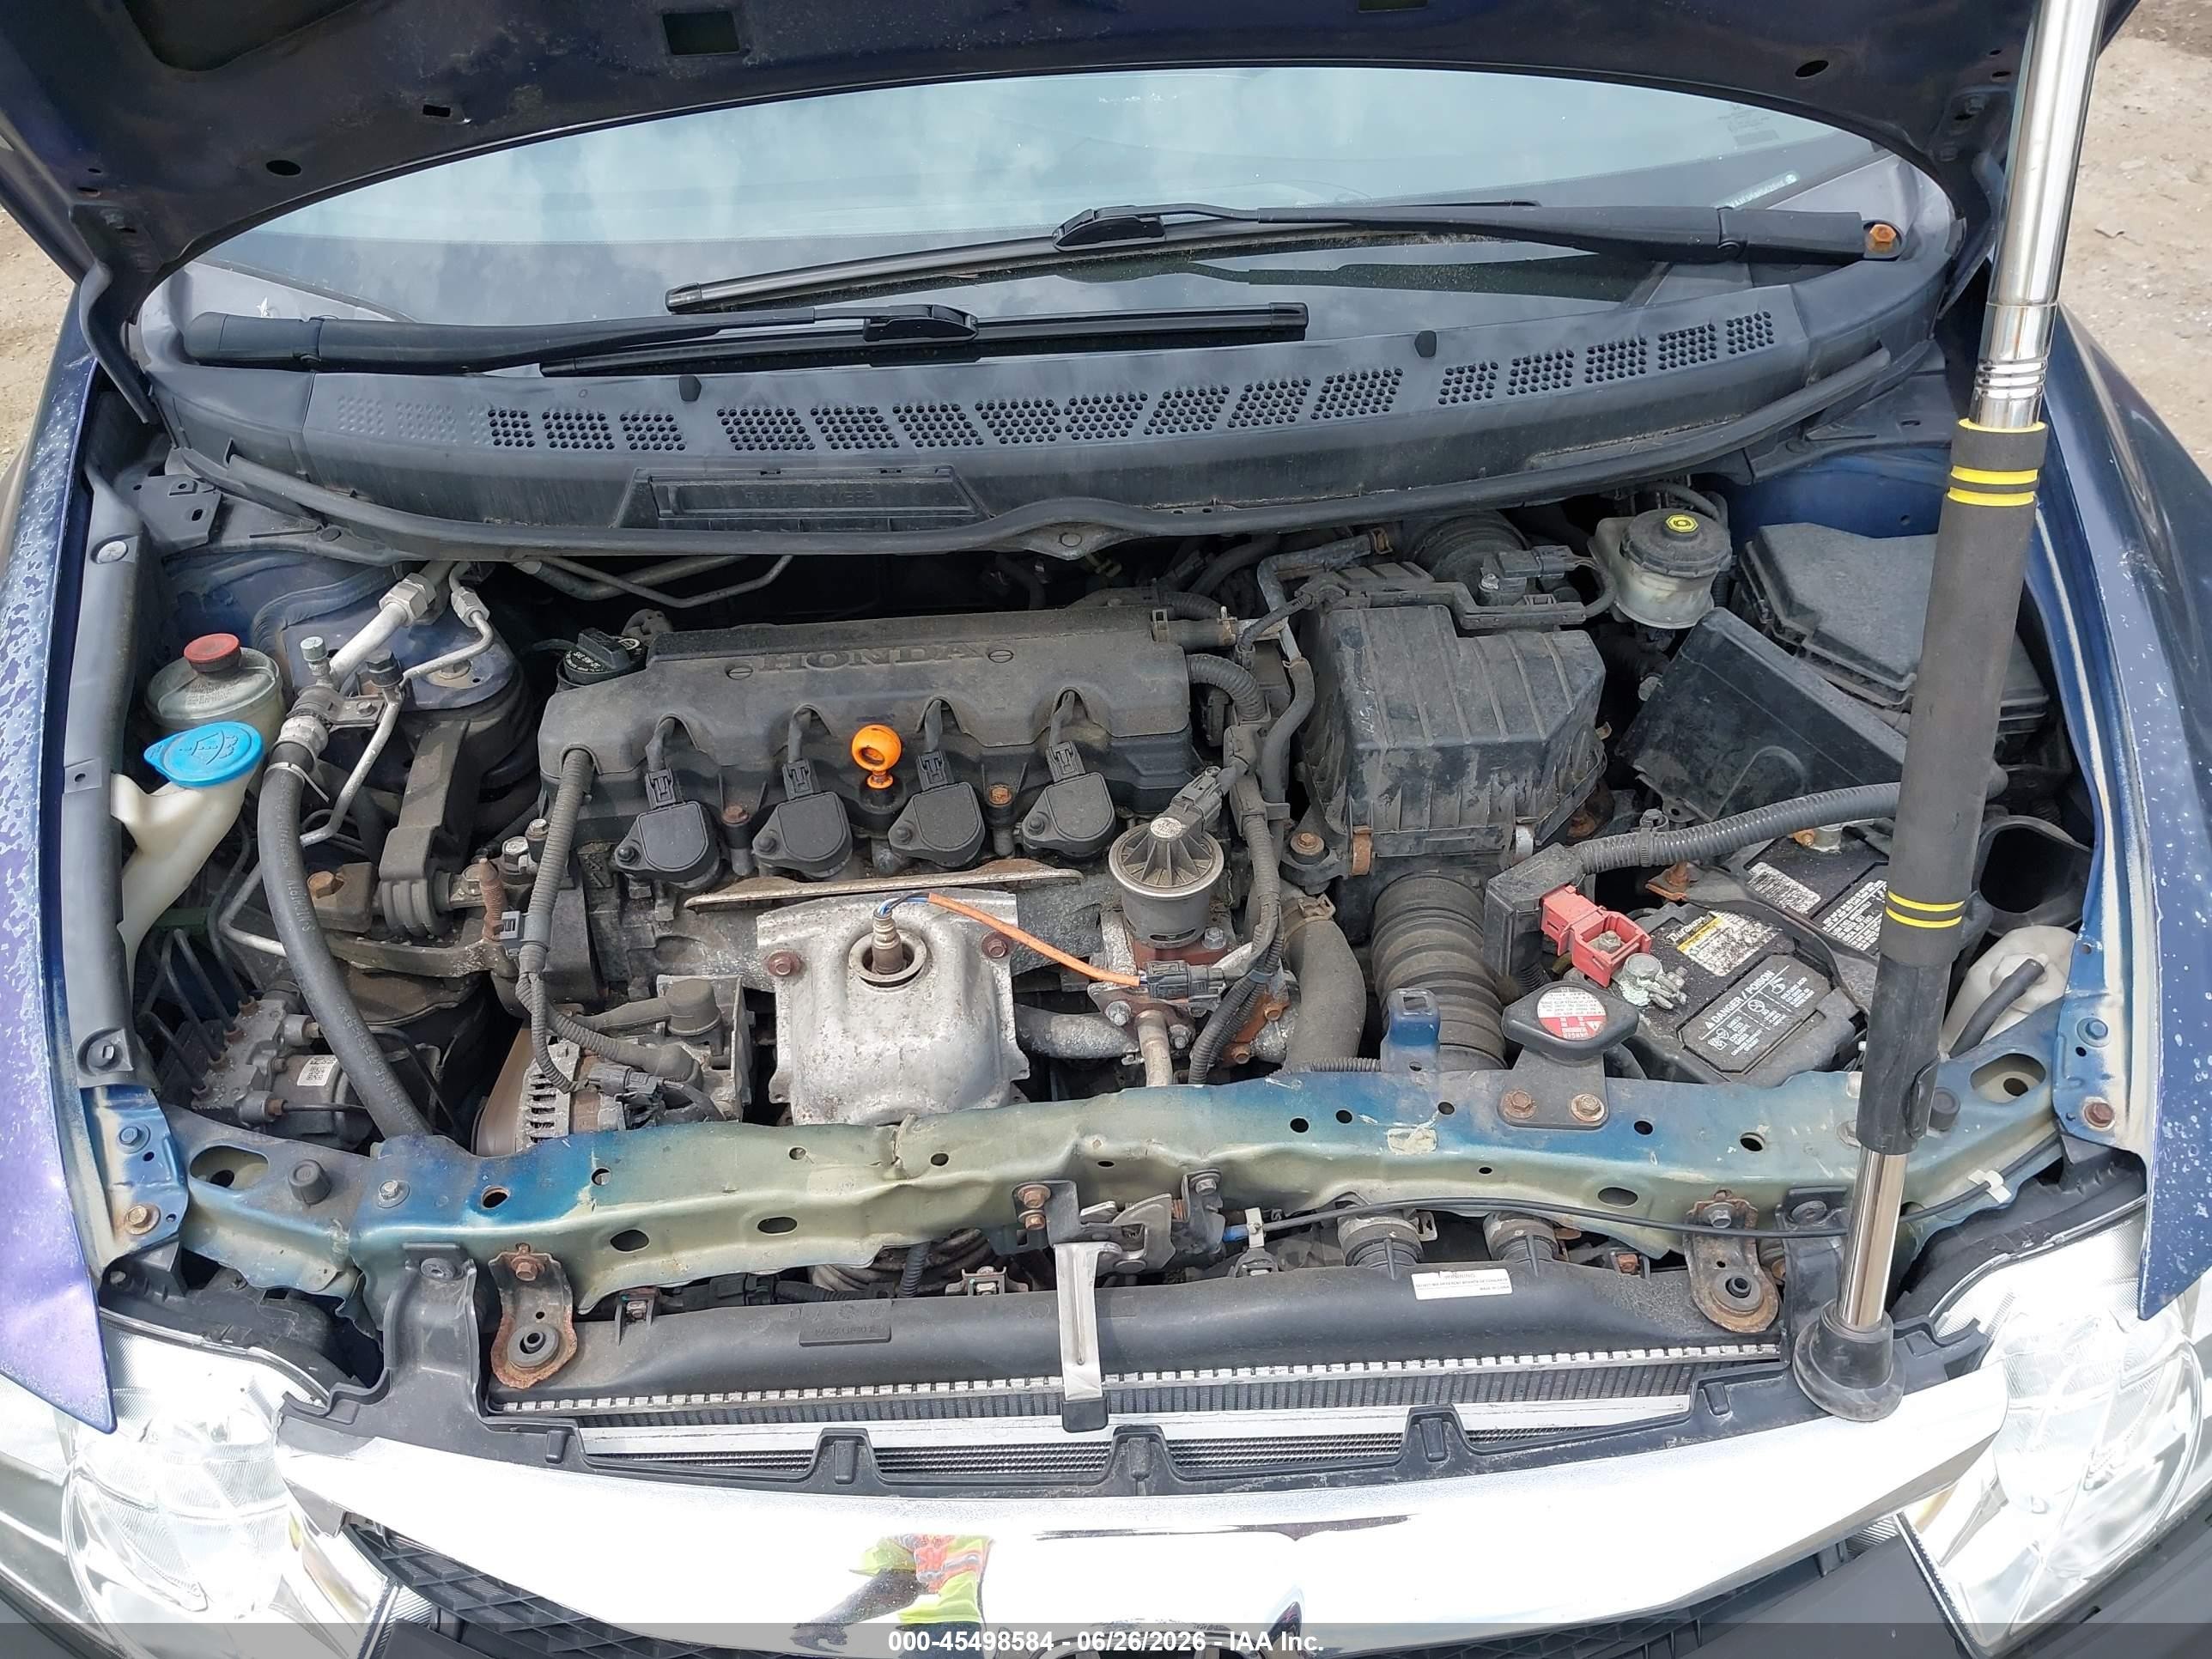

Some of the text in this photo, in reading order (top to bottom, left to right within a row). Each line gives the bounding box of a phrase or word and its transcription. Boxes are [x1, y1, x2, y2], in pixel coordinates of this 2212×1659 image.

[755, 647, 984, 672] HONDA
[1711, 996, 1744, 1022] DANGER
[1745, 969, 1775, 995] POISON
